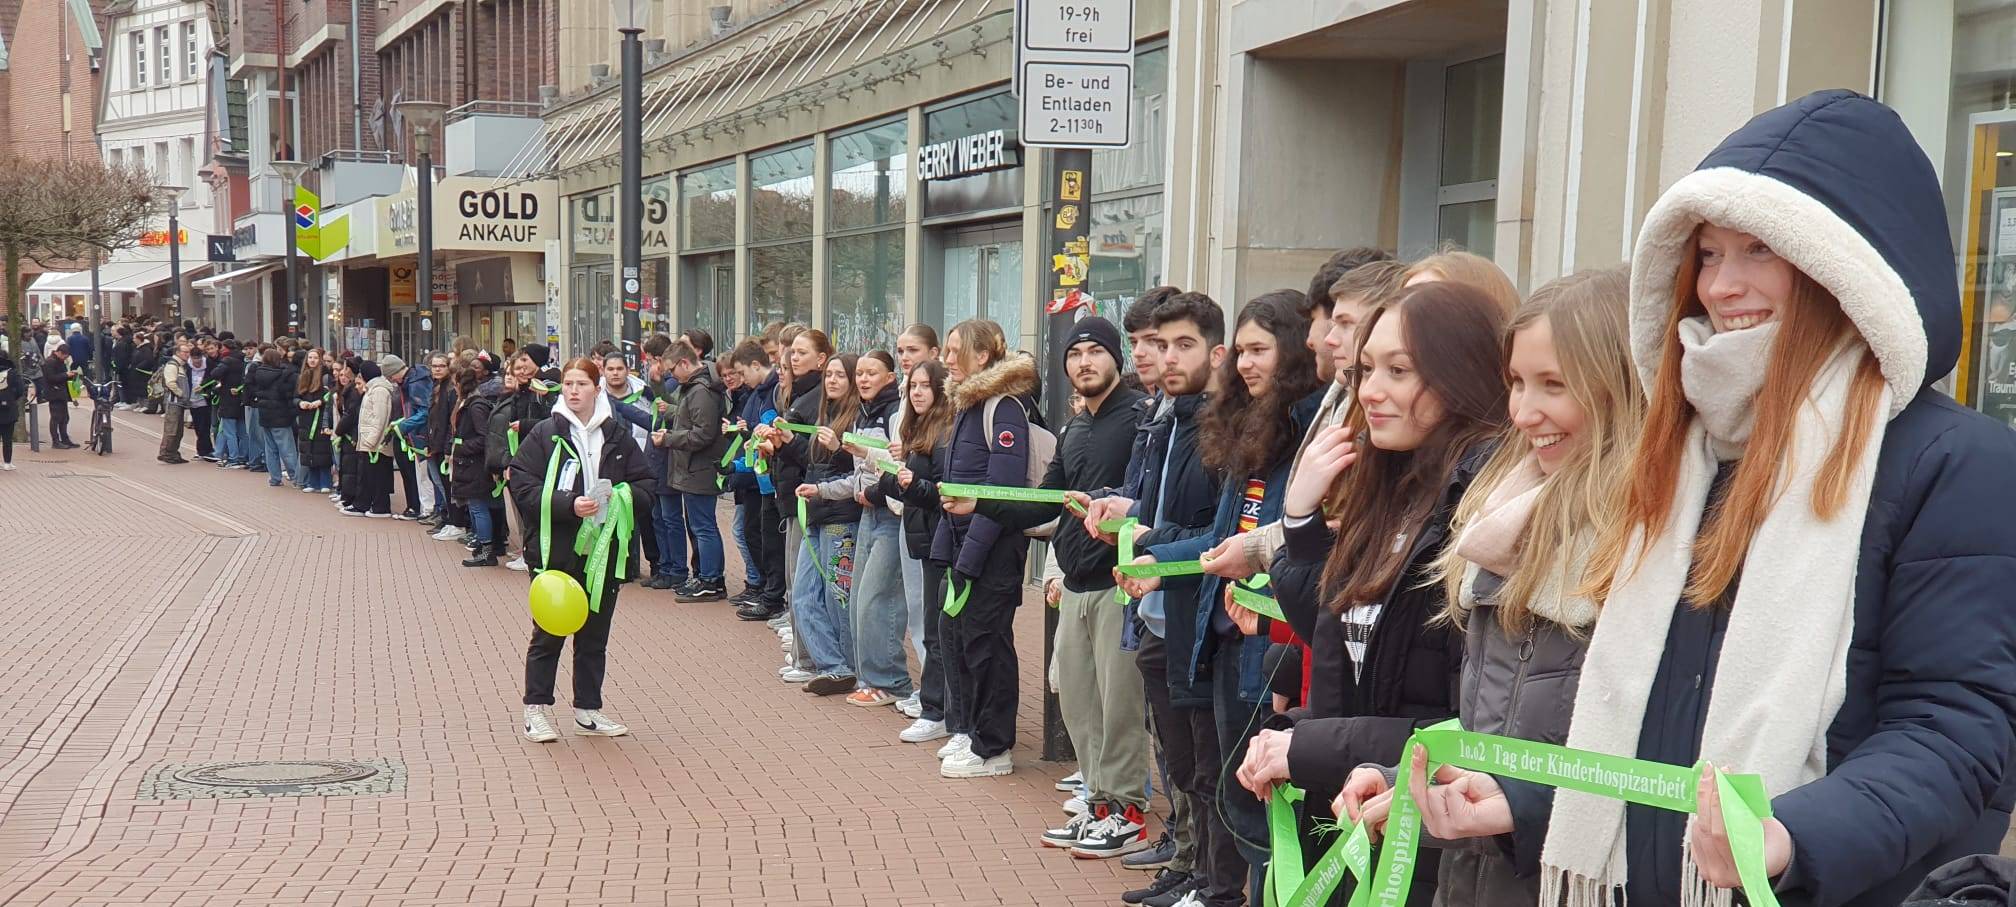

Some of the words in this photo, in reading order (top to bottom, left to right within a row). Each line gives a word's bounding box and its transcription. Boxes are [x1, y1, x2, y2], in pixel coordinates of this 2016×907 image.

[1059, 6, 1100, 22] 19-9h
[1065, 27, 1093, 43] frei
[1045, 73, 1074, 89] Be-
[1081, 75, 1110, 90] und
[1042, 95, 1112, 112] Entladen
[916, 139, 957, 181] GERRY
[958, 129, 1004, 173] WEBER
[459, 190, 538, 220] GOLD
[459, 223, 538, 243] ANKAUF
[1492, 743, 1518, 773] Tag
[1520, 748, 1544, 773] der
[1546, 752, 1687, 801] Kinderhospizarbeit
